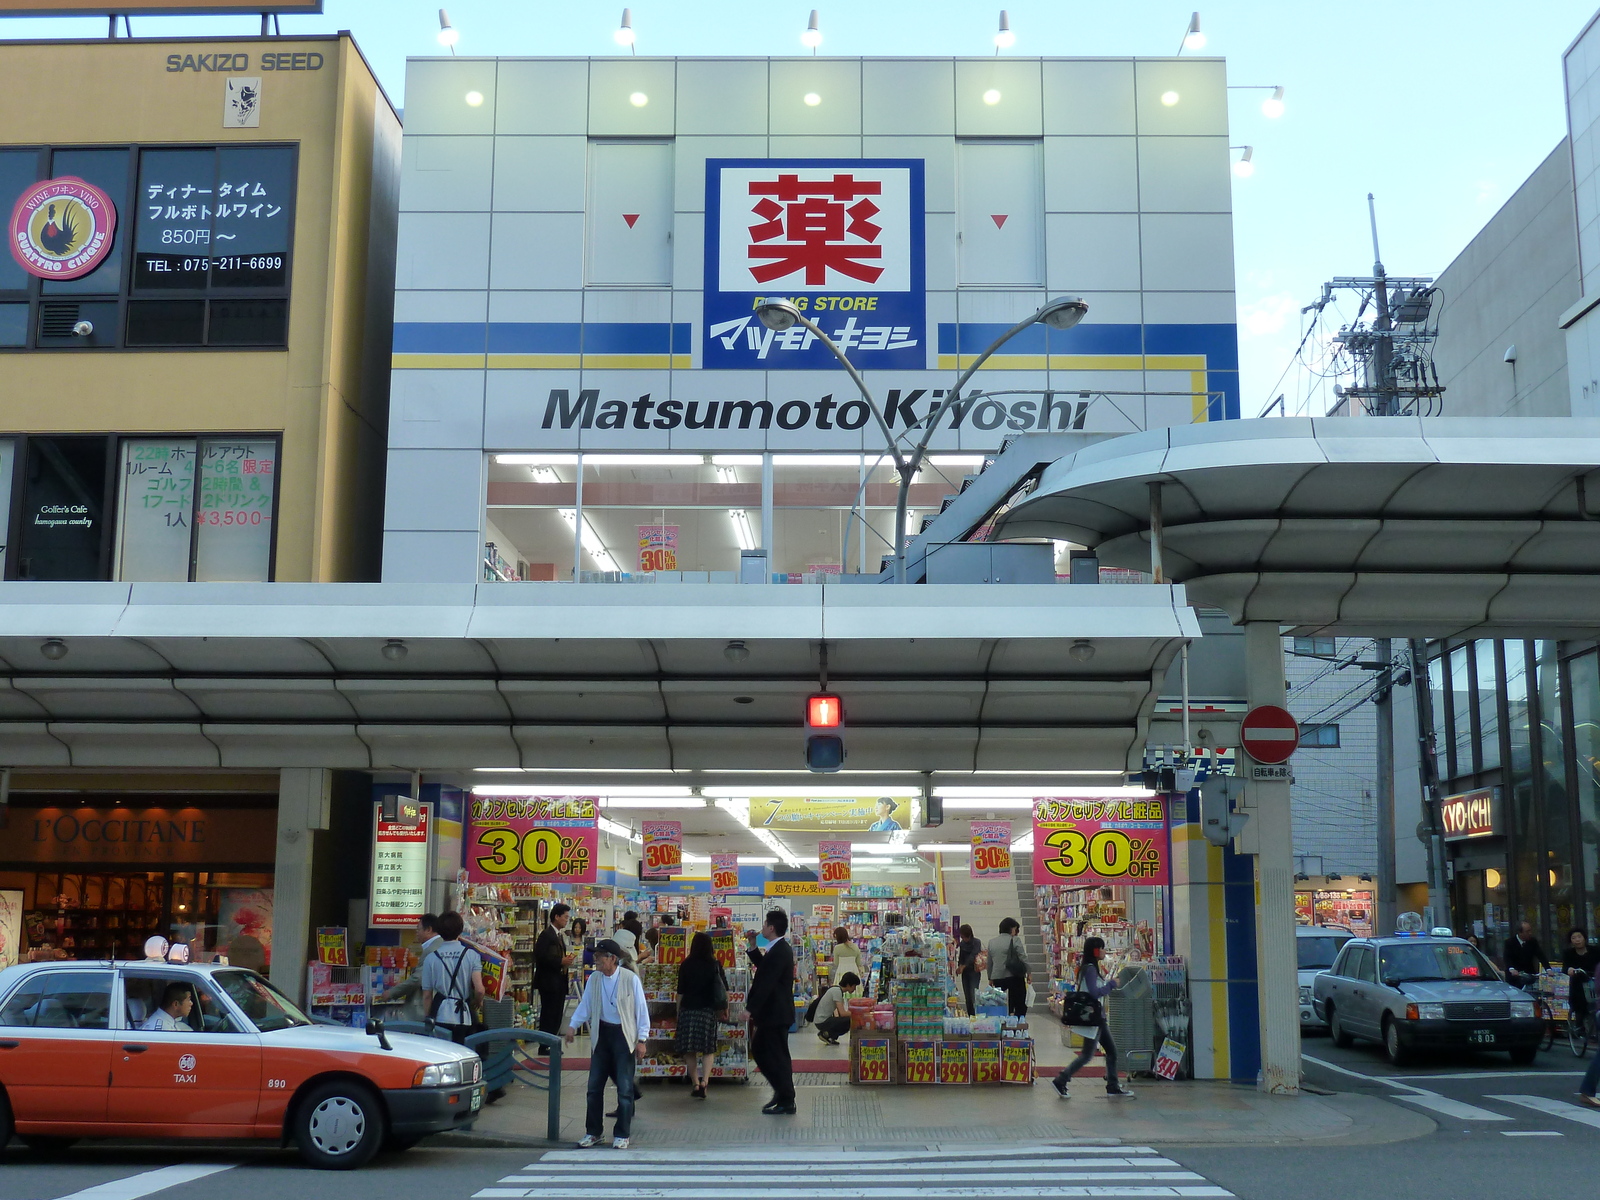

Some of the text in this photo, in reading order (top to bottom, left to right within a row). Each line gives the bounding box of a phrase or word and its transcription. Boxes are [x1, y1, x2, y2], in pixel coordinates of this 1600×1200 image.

[166, 52, 324, 73] SAKIZO SEED
[26, 190, 50, 210] WINE
[80, 190, 99, 209] VINO
[149, 203, 282, 220] フルボトルワイン
[748, 174, 885, 285] 薬
[18, 231, 105, 271] QUATTRO CINQUE
[814, 296, 878, 311] STORE
[541, 389, 1091, 430] Matsumoto KiYoshi
[164, 512, 187, 528] 1人
[1253, 768, 1292, 778] 自転車を除く
[1036, 798, 1164, 821] カウンセリング化粧品
[32, 814, 206, 843] L'OCCITANE
[557, 859, 589, 875] OFF
[1127, 860, 1160, 878] OFF
[346, 994, 365, 1004] 148
[173, 1073, 197, 1083] TAXI
[861, 1060, 888, 1080] 699
[907, 1062, 935, 1082] 799
[941, 1062, 968, 1082] 399
[973, 1062, 1000, 1082] 158
[1001, 1060, 1030, 1081] 199
[268, 1079, 286, 1088] 890
